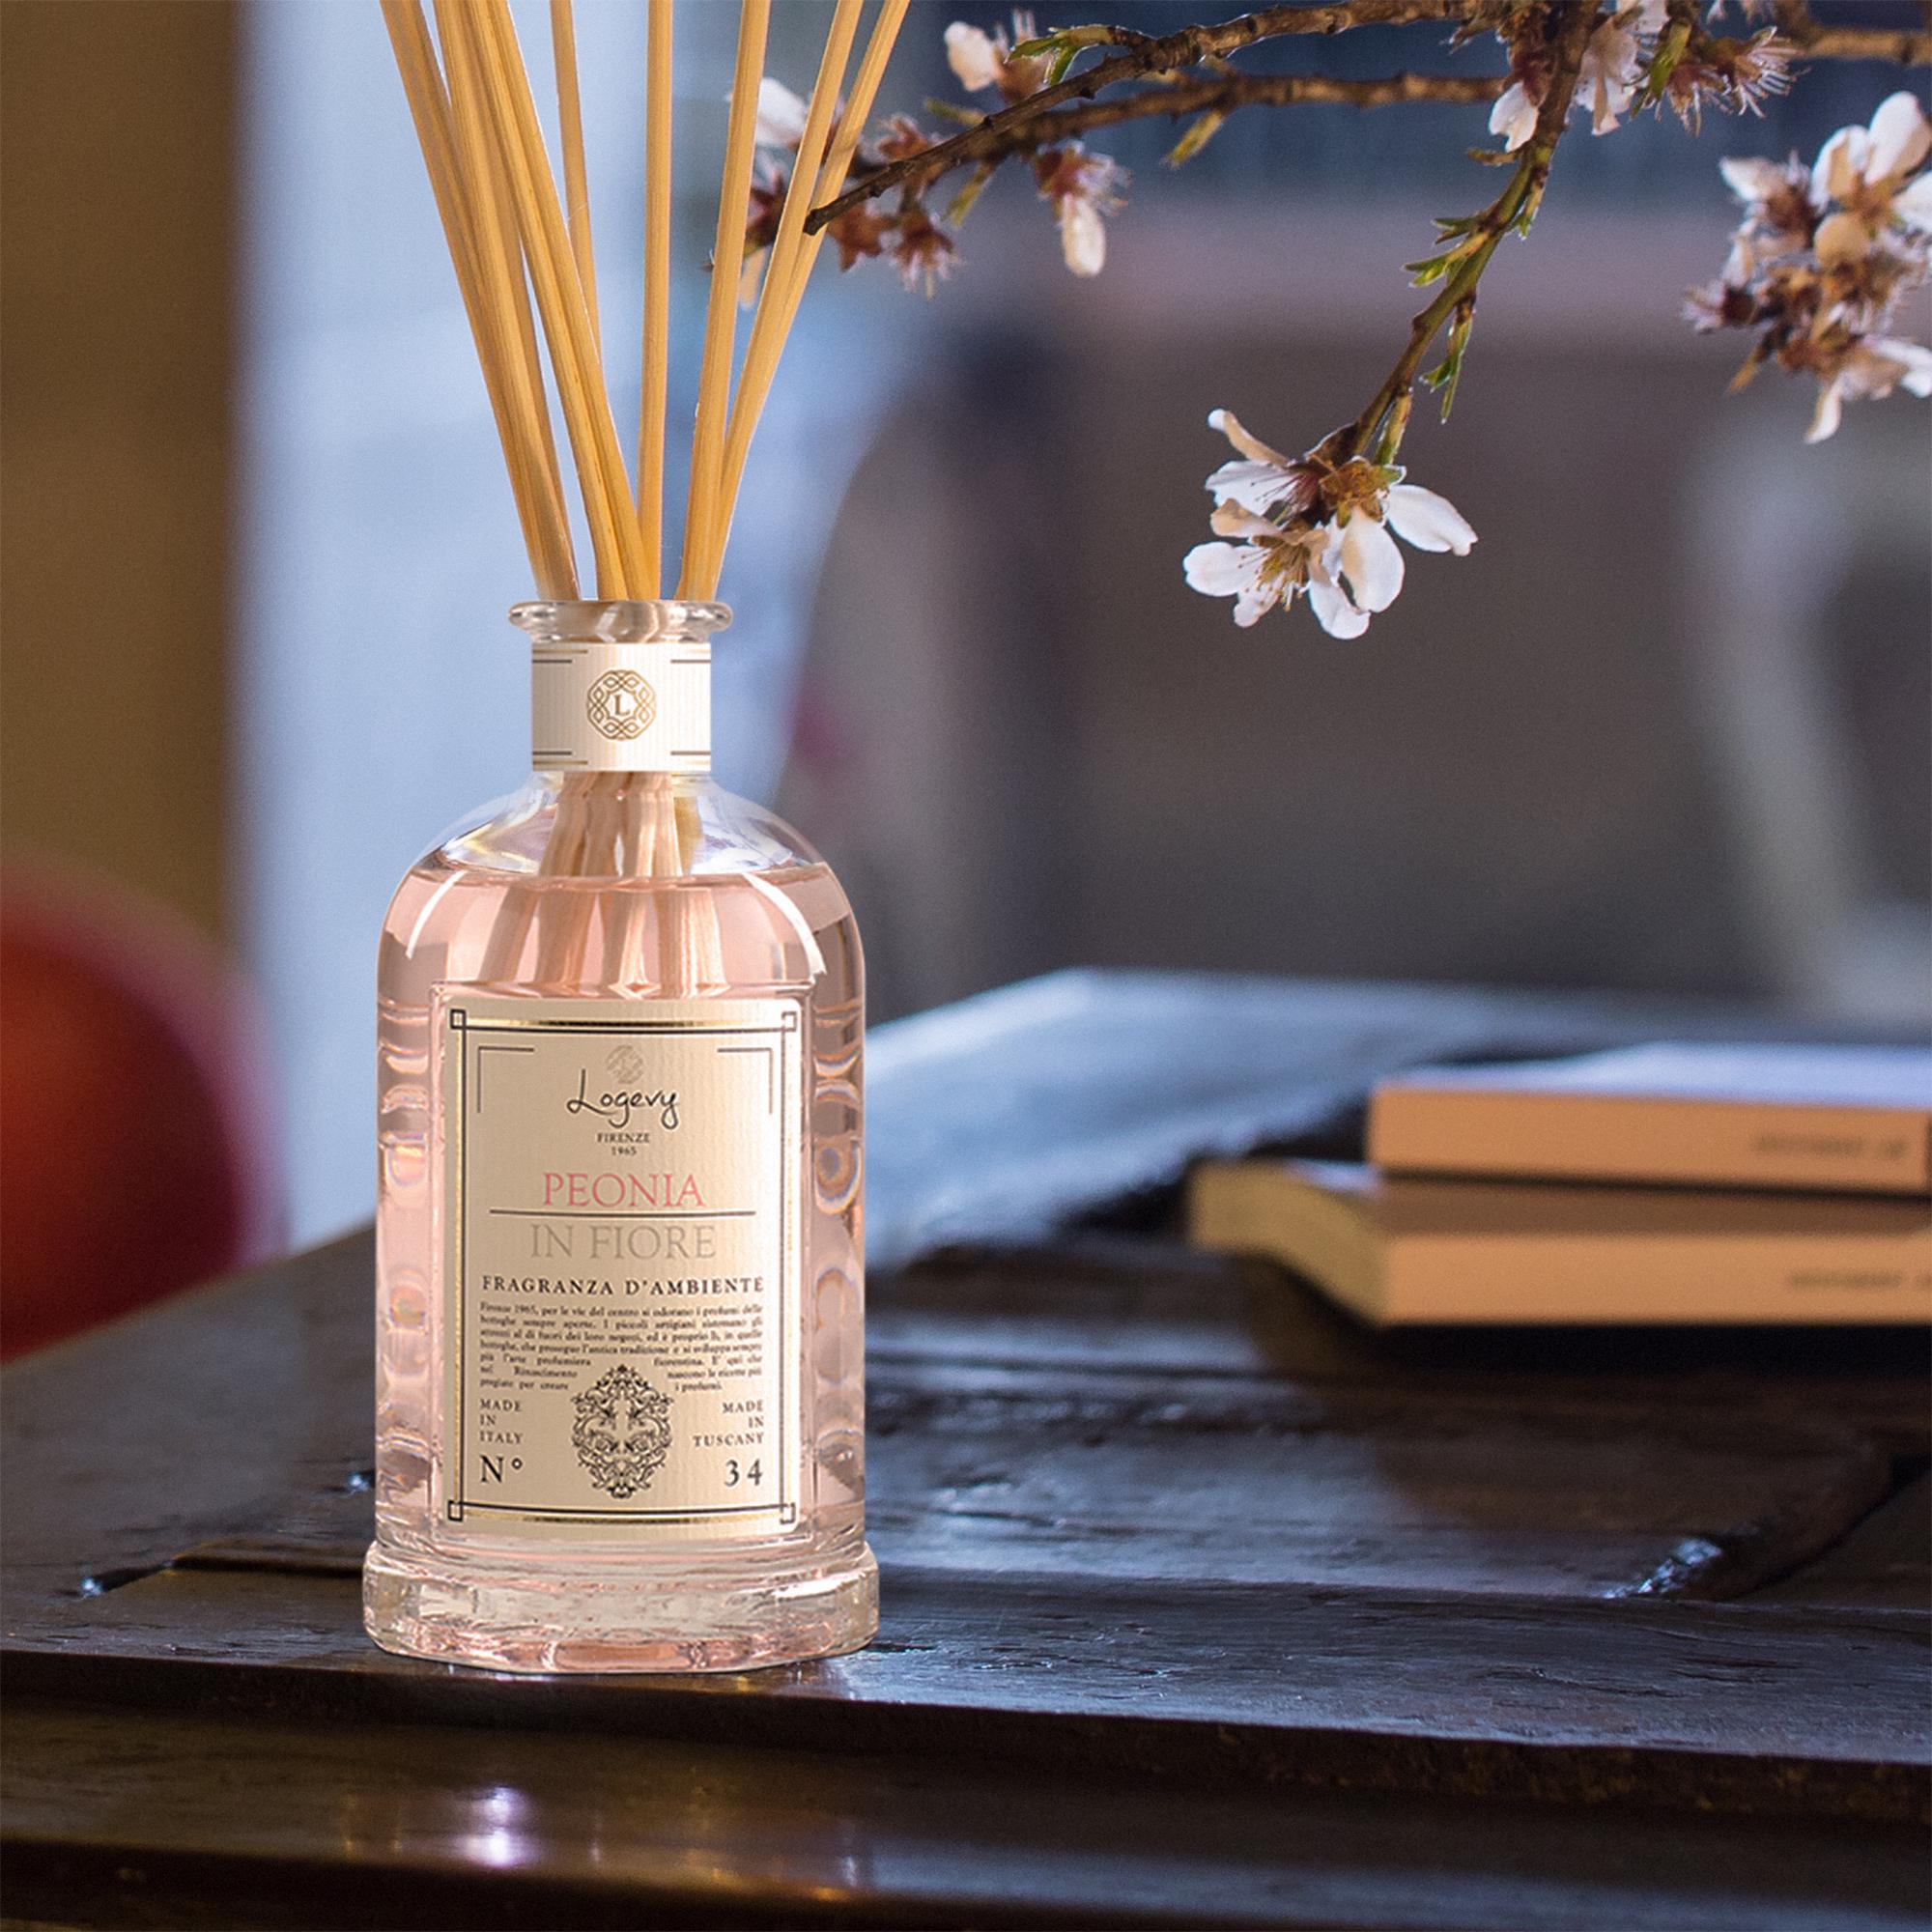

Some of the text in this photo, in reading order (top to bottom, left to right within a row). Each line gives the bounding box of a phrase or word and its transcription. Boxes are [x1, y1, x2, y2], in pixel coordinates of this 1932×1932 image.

[566, 1068, 679, 1130] Logevy
[597, 1133, 650, 1143] FIRENZE
[611, 1147, 637, 1156] 1965
[543, 1172, 704, 1208] PEONIA
[532, 1224, 716, 1260] IN FIORE
[482, 1275, 764, 1295] FRAGRANZA D'AMBIENTE
[480, 1302, 511, 1313] Firenze
[589, 1307, 605, 1316] del
[480, 1315, 516, 1326] botteghe
[480, 1398, 523, 1412] MADE
[723, 1399, 763, 1413] MADE
[480, 1414, 497, 1426] IN
[749, 1415, 764, 1429] IN
[480, 1431, 524, 1444] ITALY
[692, 1433, 764, 1447] TUSCANY
